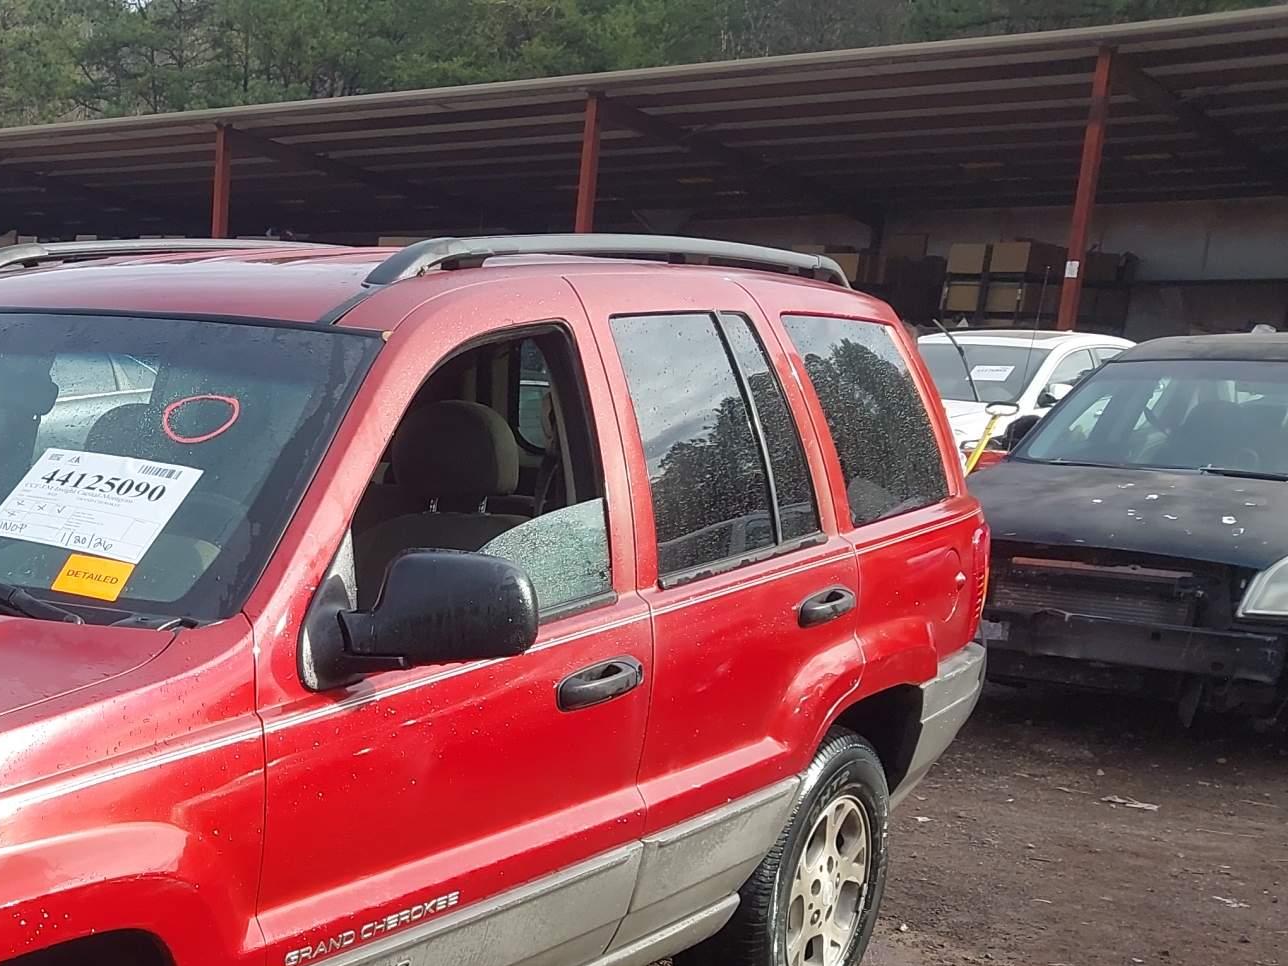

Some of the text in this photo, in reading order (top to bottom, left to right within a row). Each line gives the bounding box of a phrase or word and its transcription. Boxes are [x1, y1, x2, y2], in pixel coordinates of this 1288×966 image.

[41, 469, 166, 502] 44125090
[66, 569, 119, 585] DETAILED
[360, 890, 460, 940] CHEROKEE
